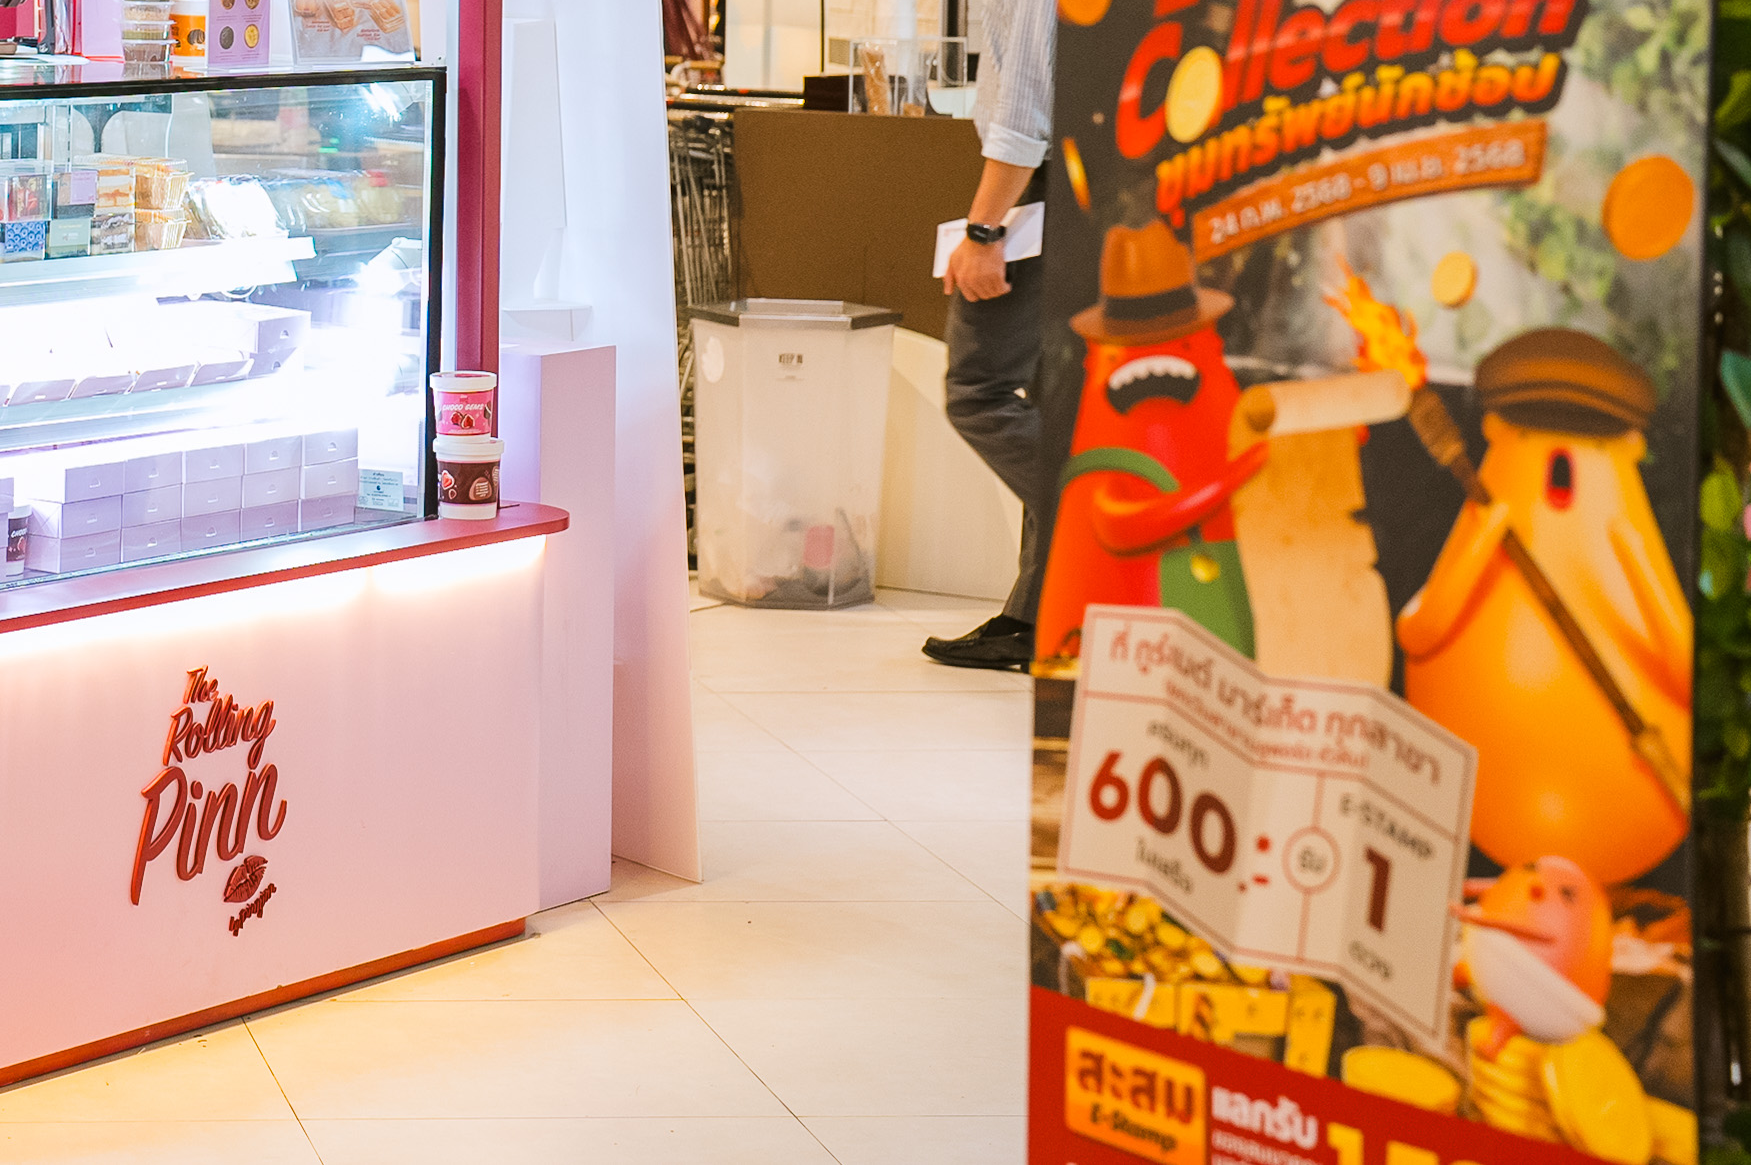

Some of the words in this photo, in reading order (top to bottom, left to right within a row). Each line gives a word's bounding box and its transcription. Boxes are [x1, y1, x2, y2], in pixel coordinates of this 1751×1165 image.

[183, 664, 219, 704] The
[163, 694, 276, 770] Rolling
[130, 763, 287, 906] Pinn
[1363, 846, 1393, 933] 1
[1076, 1048, 1196, 1126] สะสม
